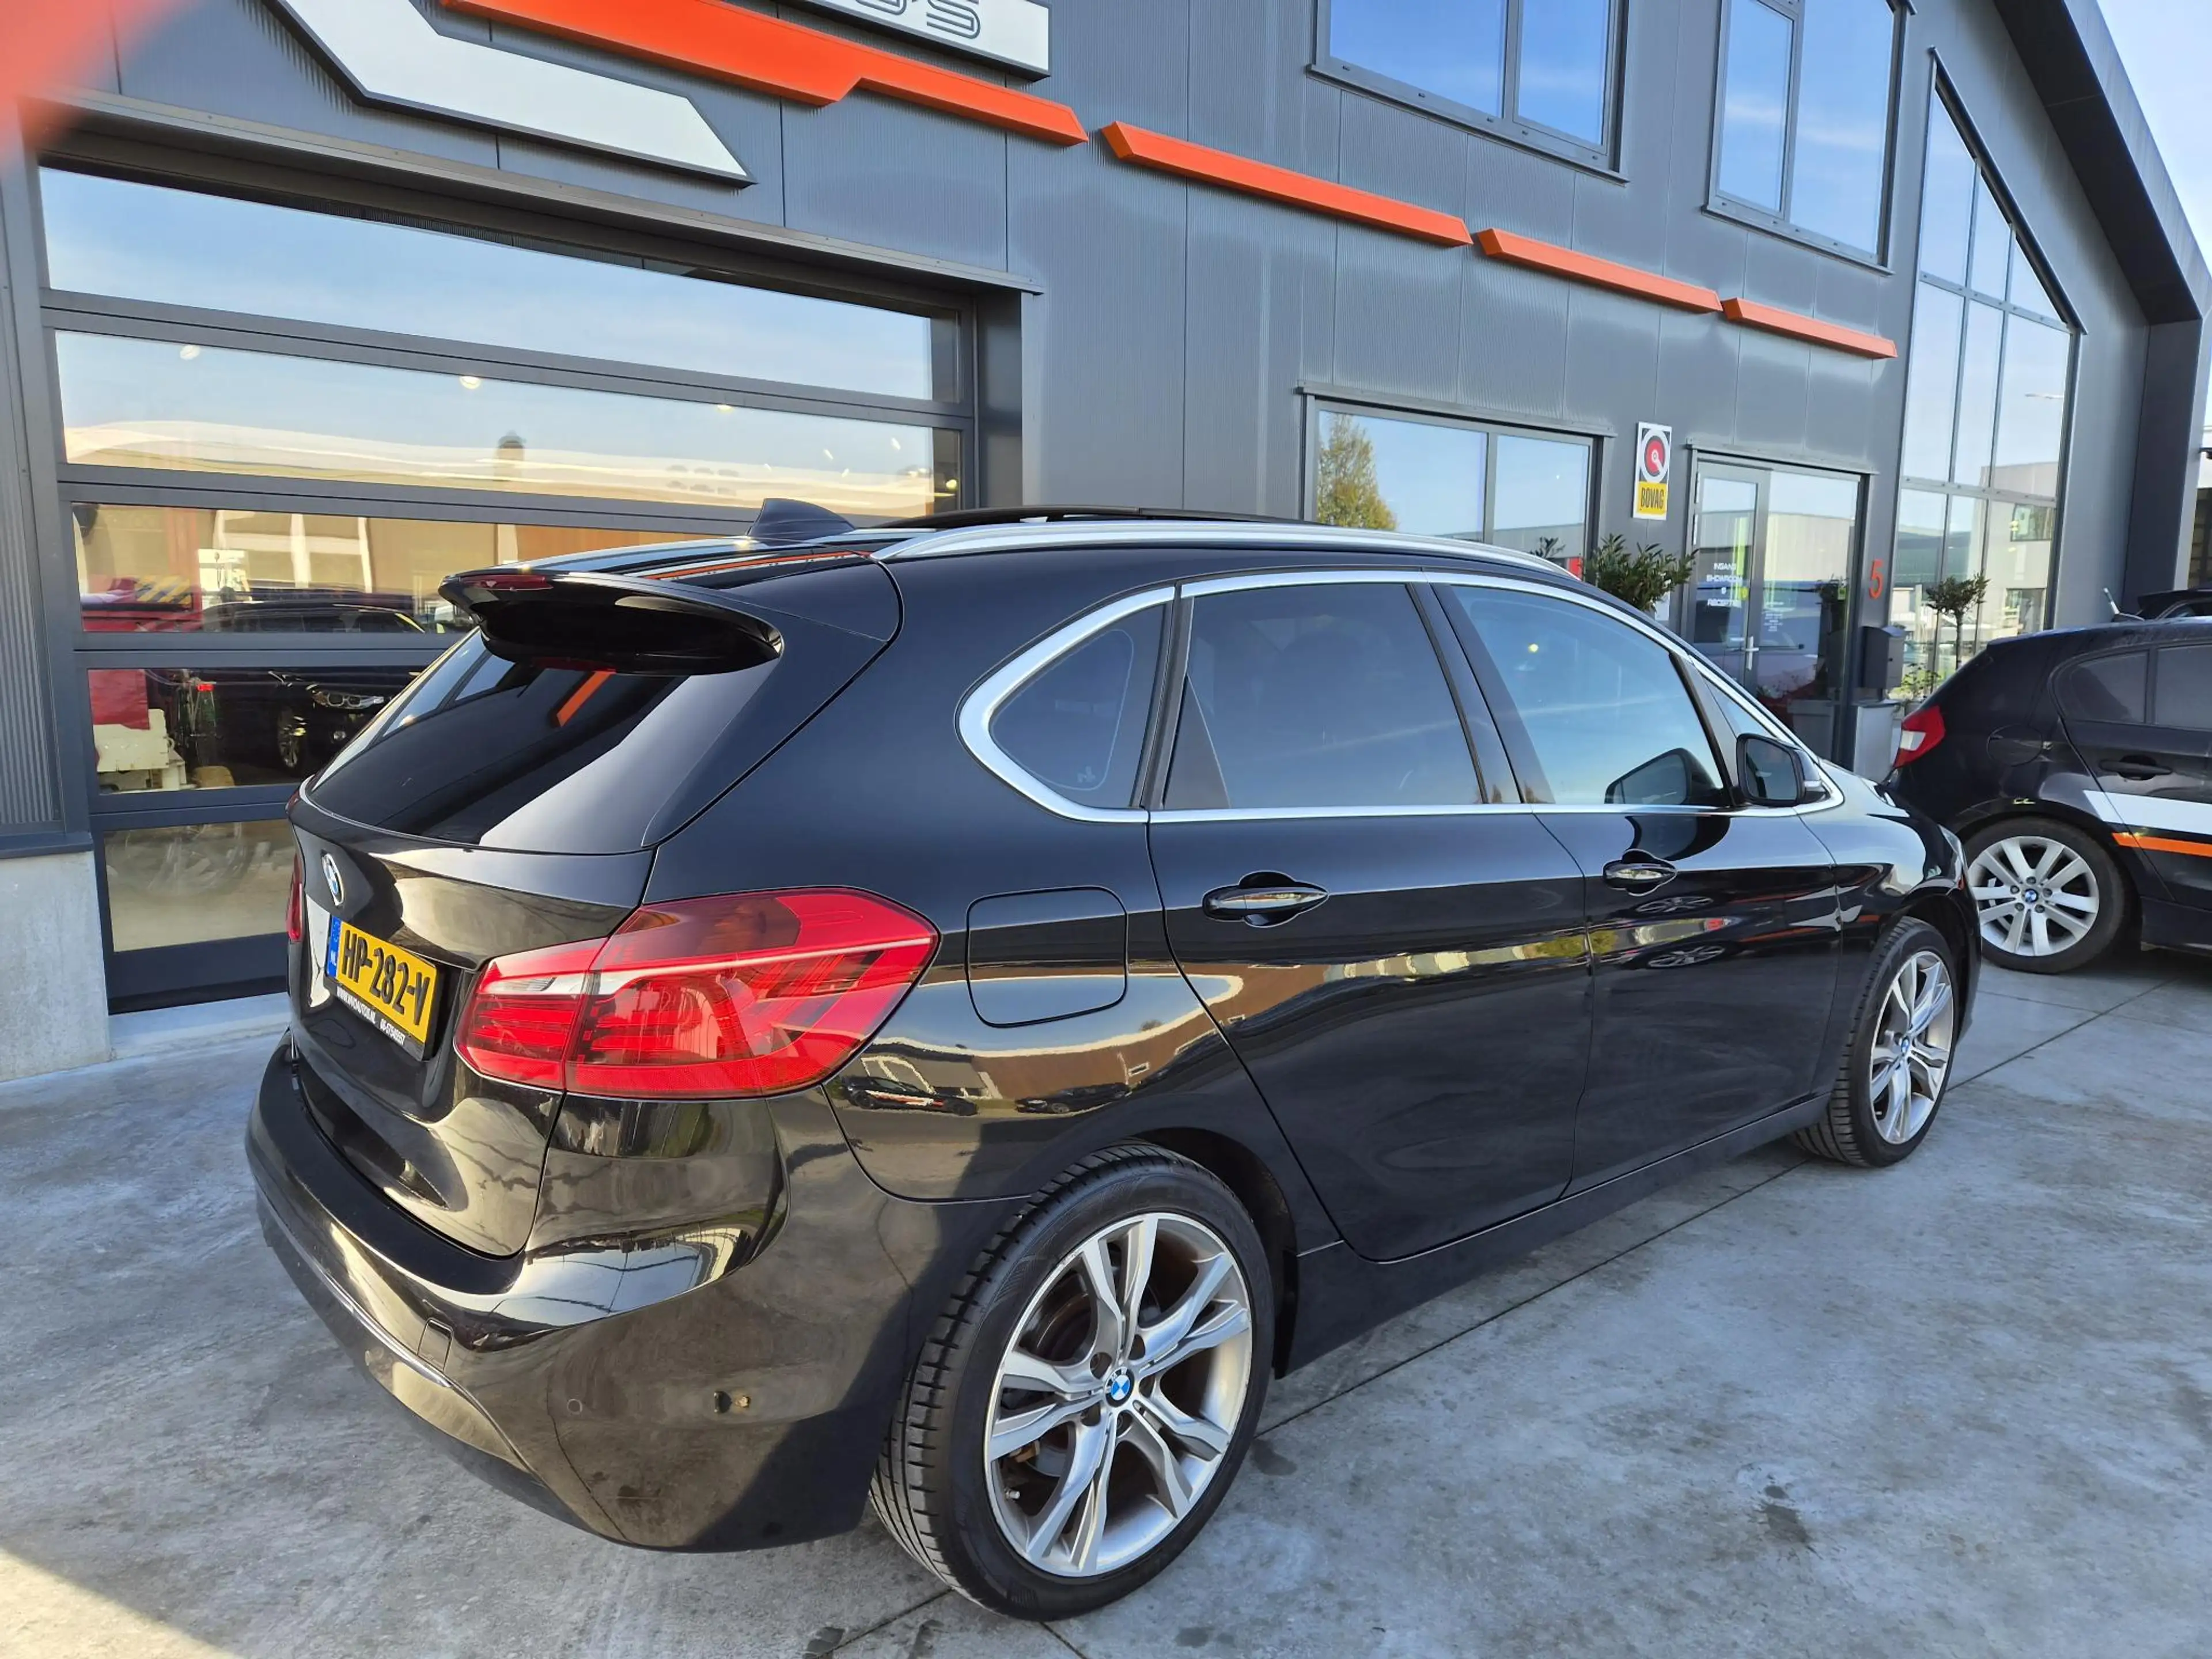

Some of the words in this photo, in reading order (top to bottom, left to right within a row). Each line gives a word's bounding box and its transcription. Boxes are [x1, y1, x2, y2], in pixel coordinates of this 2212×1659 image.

[1641, 487, 1664, 510] BOVAG
[1869, 559, 1883, 599] 5
[342, 929, 431, 1026] HP-282-V
